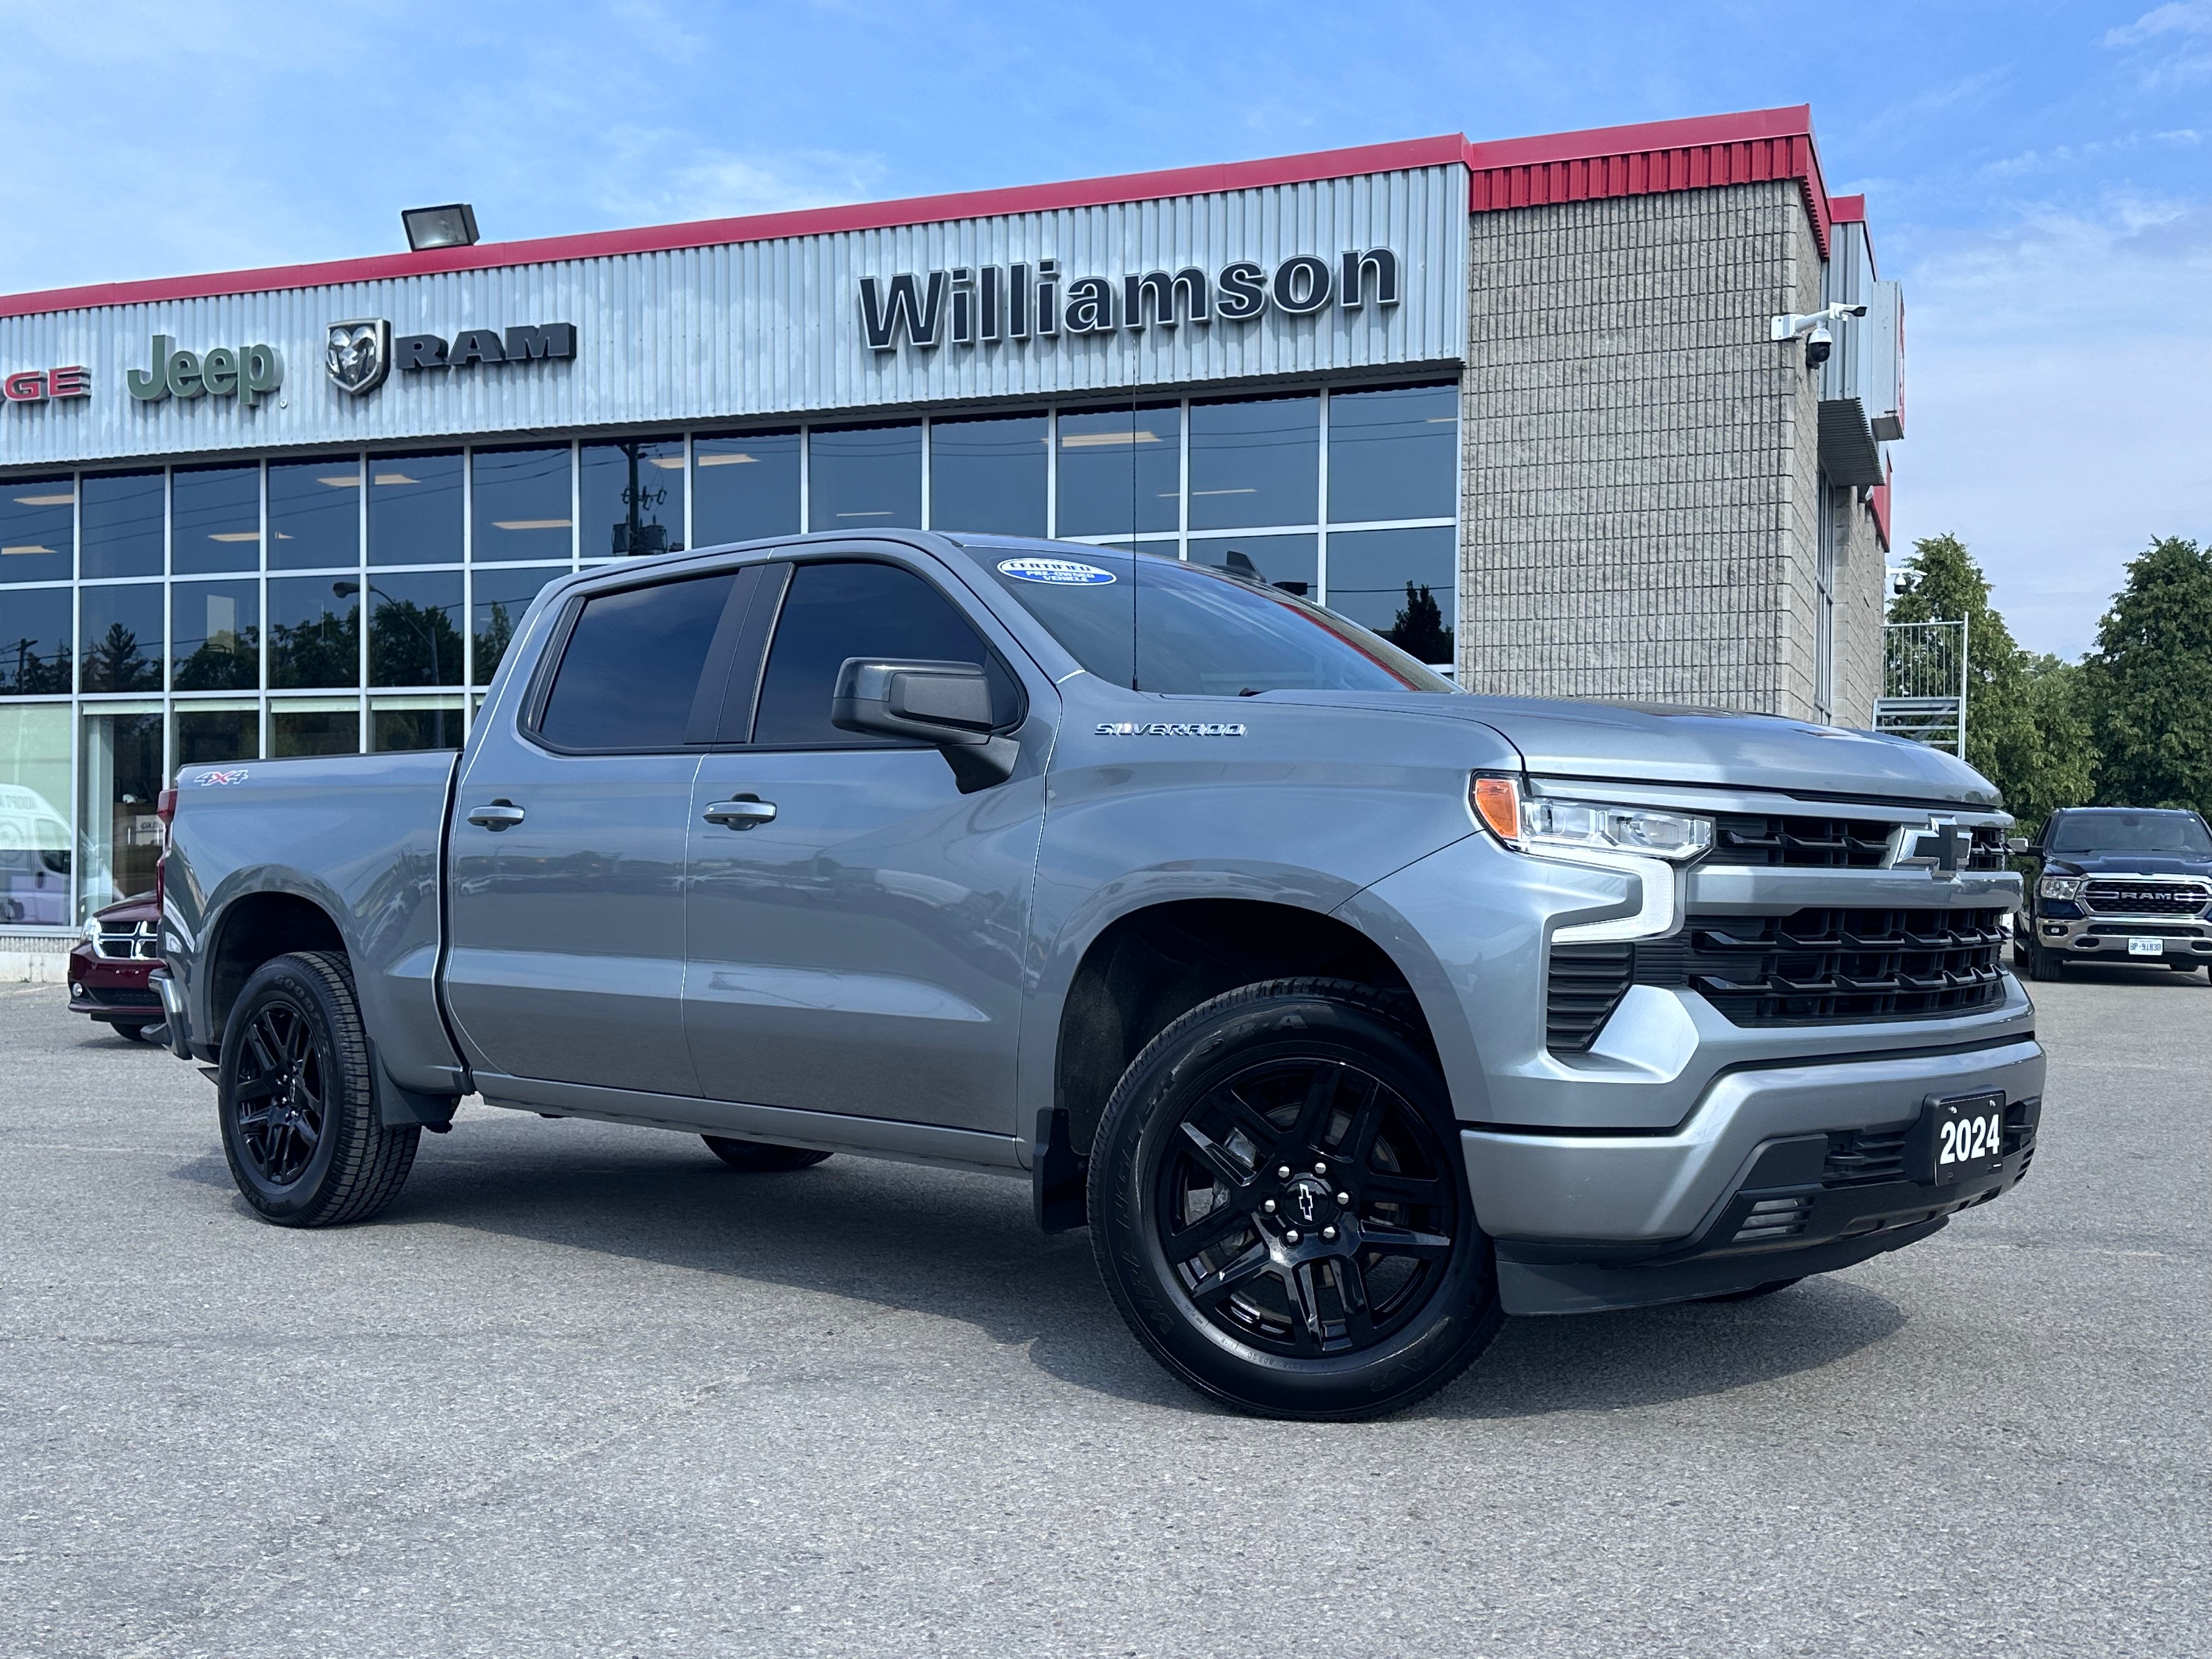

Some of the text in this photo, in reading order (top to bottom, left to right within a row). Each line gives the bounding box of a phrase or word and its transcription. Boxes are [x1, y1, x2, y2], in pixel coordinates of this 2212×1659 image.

[859, 246, 1400, 350] Williamson
[127, 334, 284, 407] Jeep
[395, 323, 576, 370] RAM
[1010, 562, 1092, 571] CERTIFIED
[1094, 723, 1246, 737] SILVERADO
[1940, 1114, 2000, 1165] 2024
